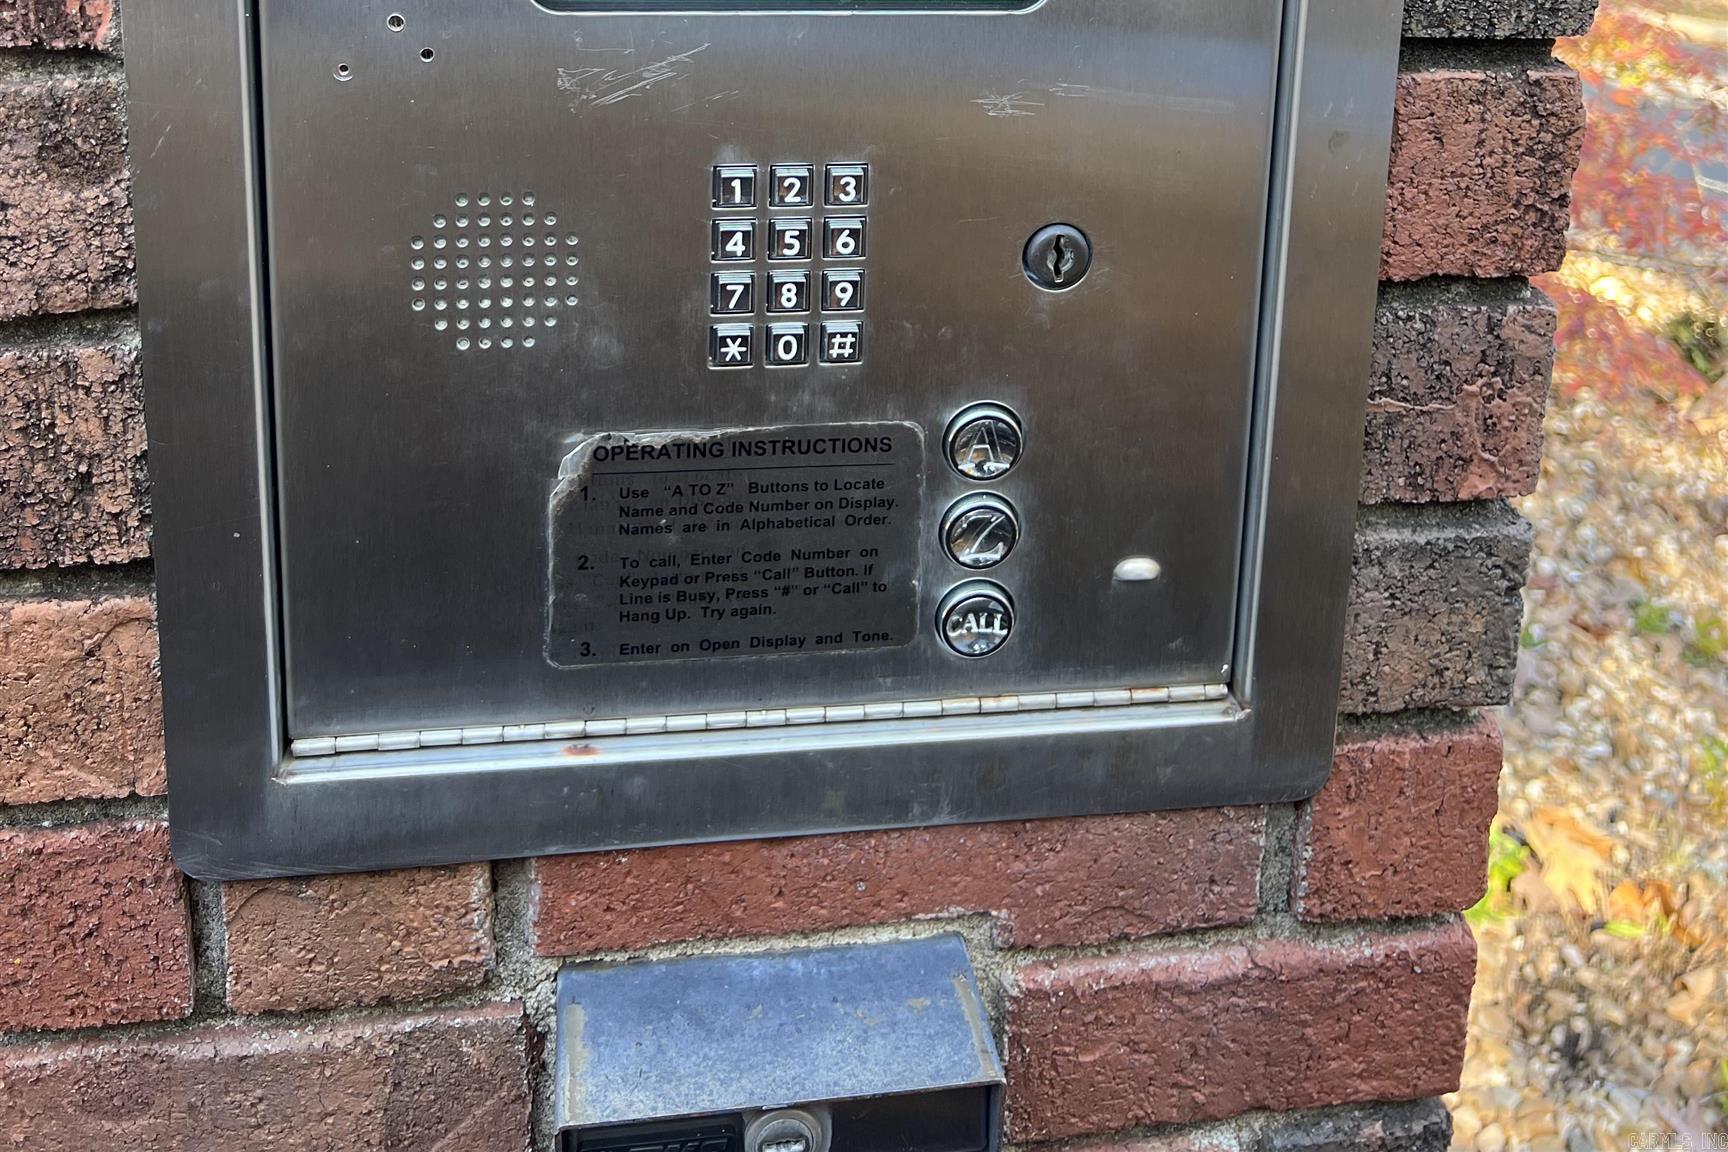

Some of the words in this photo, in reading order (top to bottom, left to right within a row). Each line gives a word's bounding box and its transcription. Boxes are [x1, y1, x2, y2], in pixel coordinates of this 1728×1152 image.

[731, 178, 742, 204] 1
[783, 177, 801, 203] 2
[838, 176, 857, 202] 3
[725, 231, 746, 257] 4
[782, 230, 801, 256] 5
[835, 229, 856, 255] 6
[726, 284, 744, 309] 7
[780, 283, 798, 308] 8
[834, 281, 854, 307] 9
[592, 441, 724, 462] OPERATING
[731, 436, 893, 458] INSTRUCTIONS
[958, 419, 1009, 468] A
[579, 486, 597, 502] 1.
[619, 487, 650, 500] Use
[688, 484, 712, 498] TO
[748, 480, 809, 495] Buttons
[814, 480, 829, 493] to
[834, 478, 885, 492] Locate
[618, 504, 664, 519] Name
[668, 503, 698, 517] and
[703, 501, 744, 516] Code
[749, 499, 810, 514] Number
[814, 499, 834, 512] on
[838, 496, 899, 512] Display.
[618, 522, 673, 537] Names
[681, 521, 707, 534] are
[716, 519, 730, 533] in
[739, 515, 836, 534] Alphabetical
[844, 513, 892, 528] Order.
[958, 514, 1006, 561] Z
[577, 554, 595, 571] 2.
[619, 556, 640, 570] To
[649, 555, 681, 569] call,
[690, 552, 732, 567] Enter
[741, 550, 782, 565] Code
[790, 548, 850, 563] Number
[859, 546, 879, 559] on
[619, 573, 679, 591] Keypad
[684, 572, 700, 585] or
[704, 570, 749, 584] Press
[803, 564, 859, 579] Button.
[863, 562, 874, 577] If
[619, 592, 653, 606] Line
[658, 591, 671, 604] is
[676, 588, 720, 604] Busy,
[725, 586, 769, 600] Press
[803, 584, 820, 597] or
[872, 579, 888, 593] to
[619, 610, 660, 624] Hang
[665, 608, 691, 622] Up.
[700, 605, 726, 620] Try
[730, 602, 777, 619] again.
[946, 612, 1009, 638] CALL
[579, 641, 597, 658] 3.
[619, 641, 662, 656] Enter
[670, 639, 690, 653] on
[699, 636, 741, 654] Open
[750, 633, 807, 650] Display
[815, 630, 843, 645] and
[852, 629, 894, 643] Tone.
